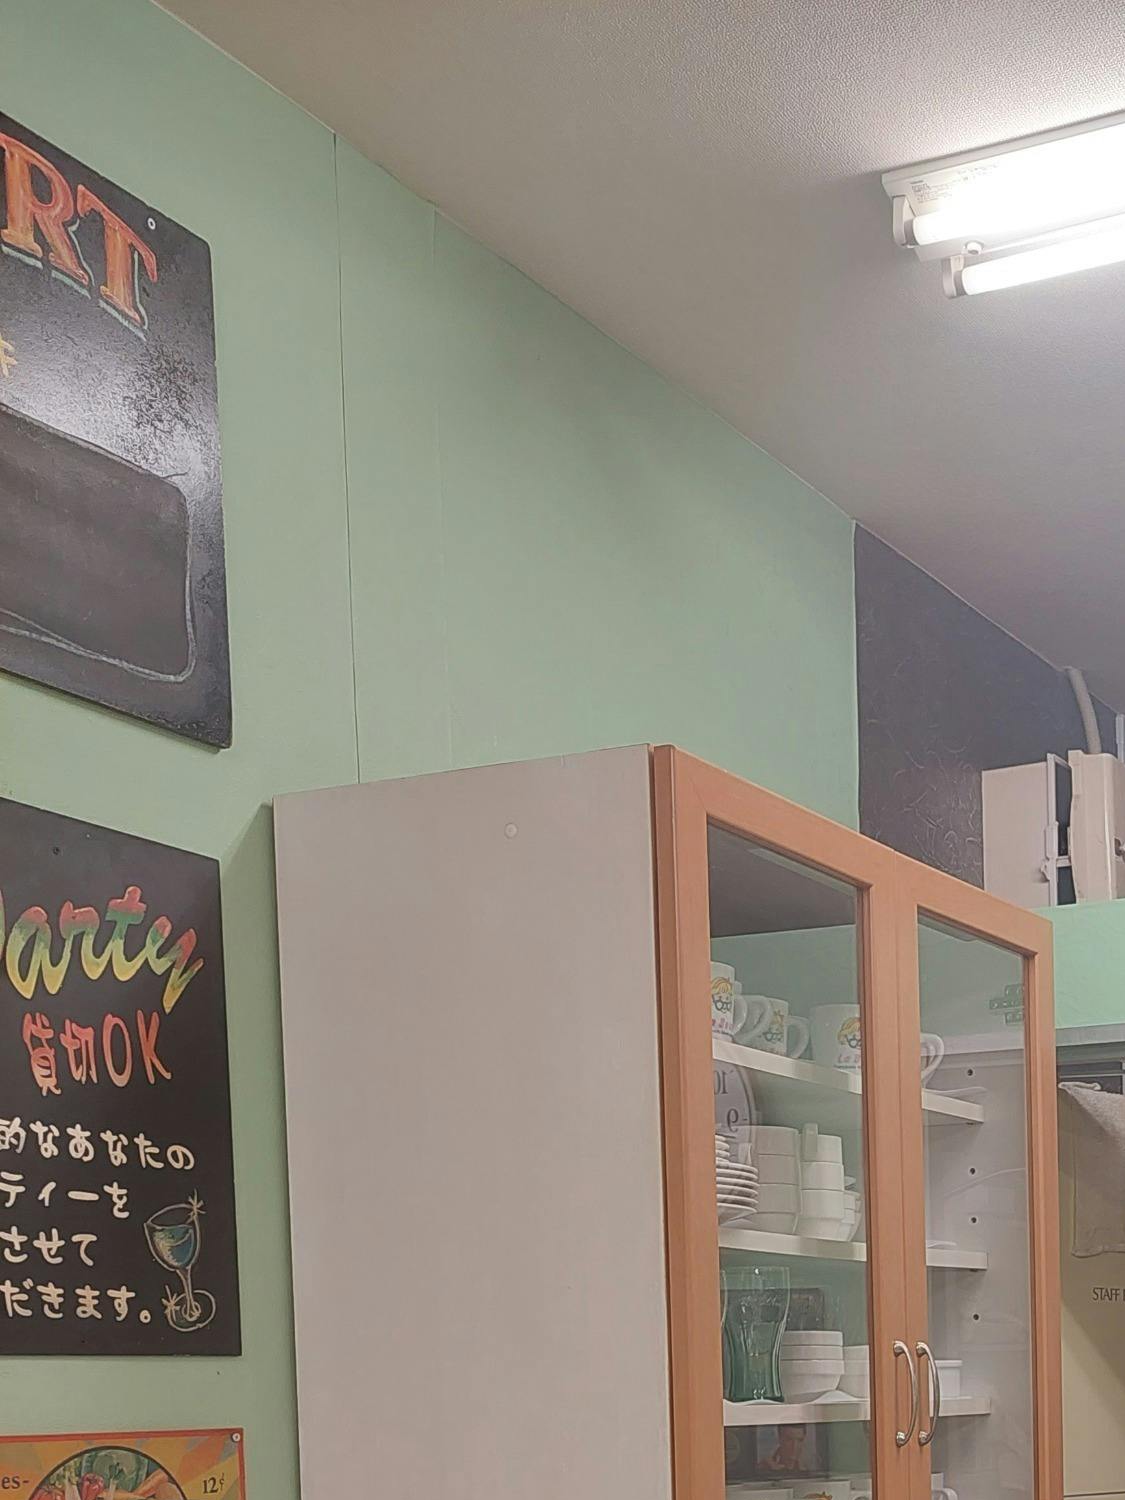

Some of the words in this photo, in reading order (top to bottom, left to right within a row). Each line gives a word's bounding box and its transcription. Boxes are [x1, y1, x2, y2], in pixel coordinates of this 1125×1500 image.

[0, 132, 158, 336] RT
[0, 886, 204, 1014] arty
[23, 1007, 172, 1096] 貸切OK
[0, 1171, 130, 1219] ティーを
[0, 1226, 98, 1266] させて
[0, 1278, 152, 1326] だきます。
[1092, 1287, 1120, 1301] STAFF
